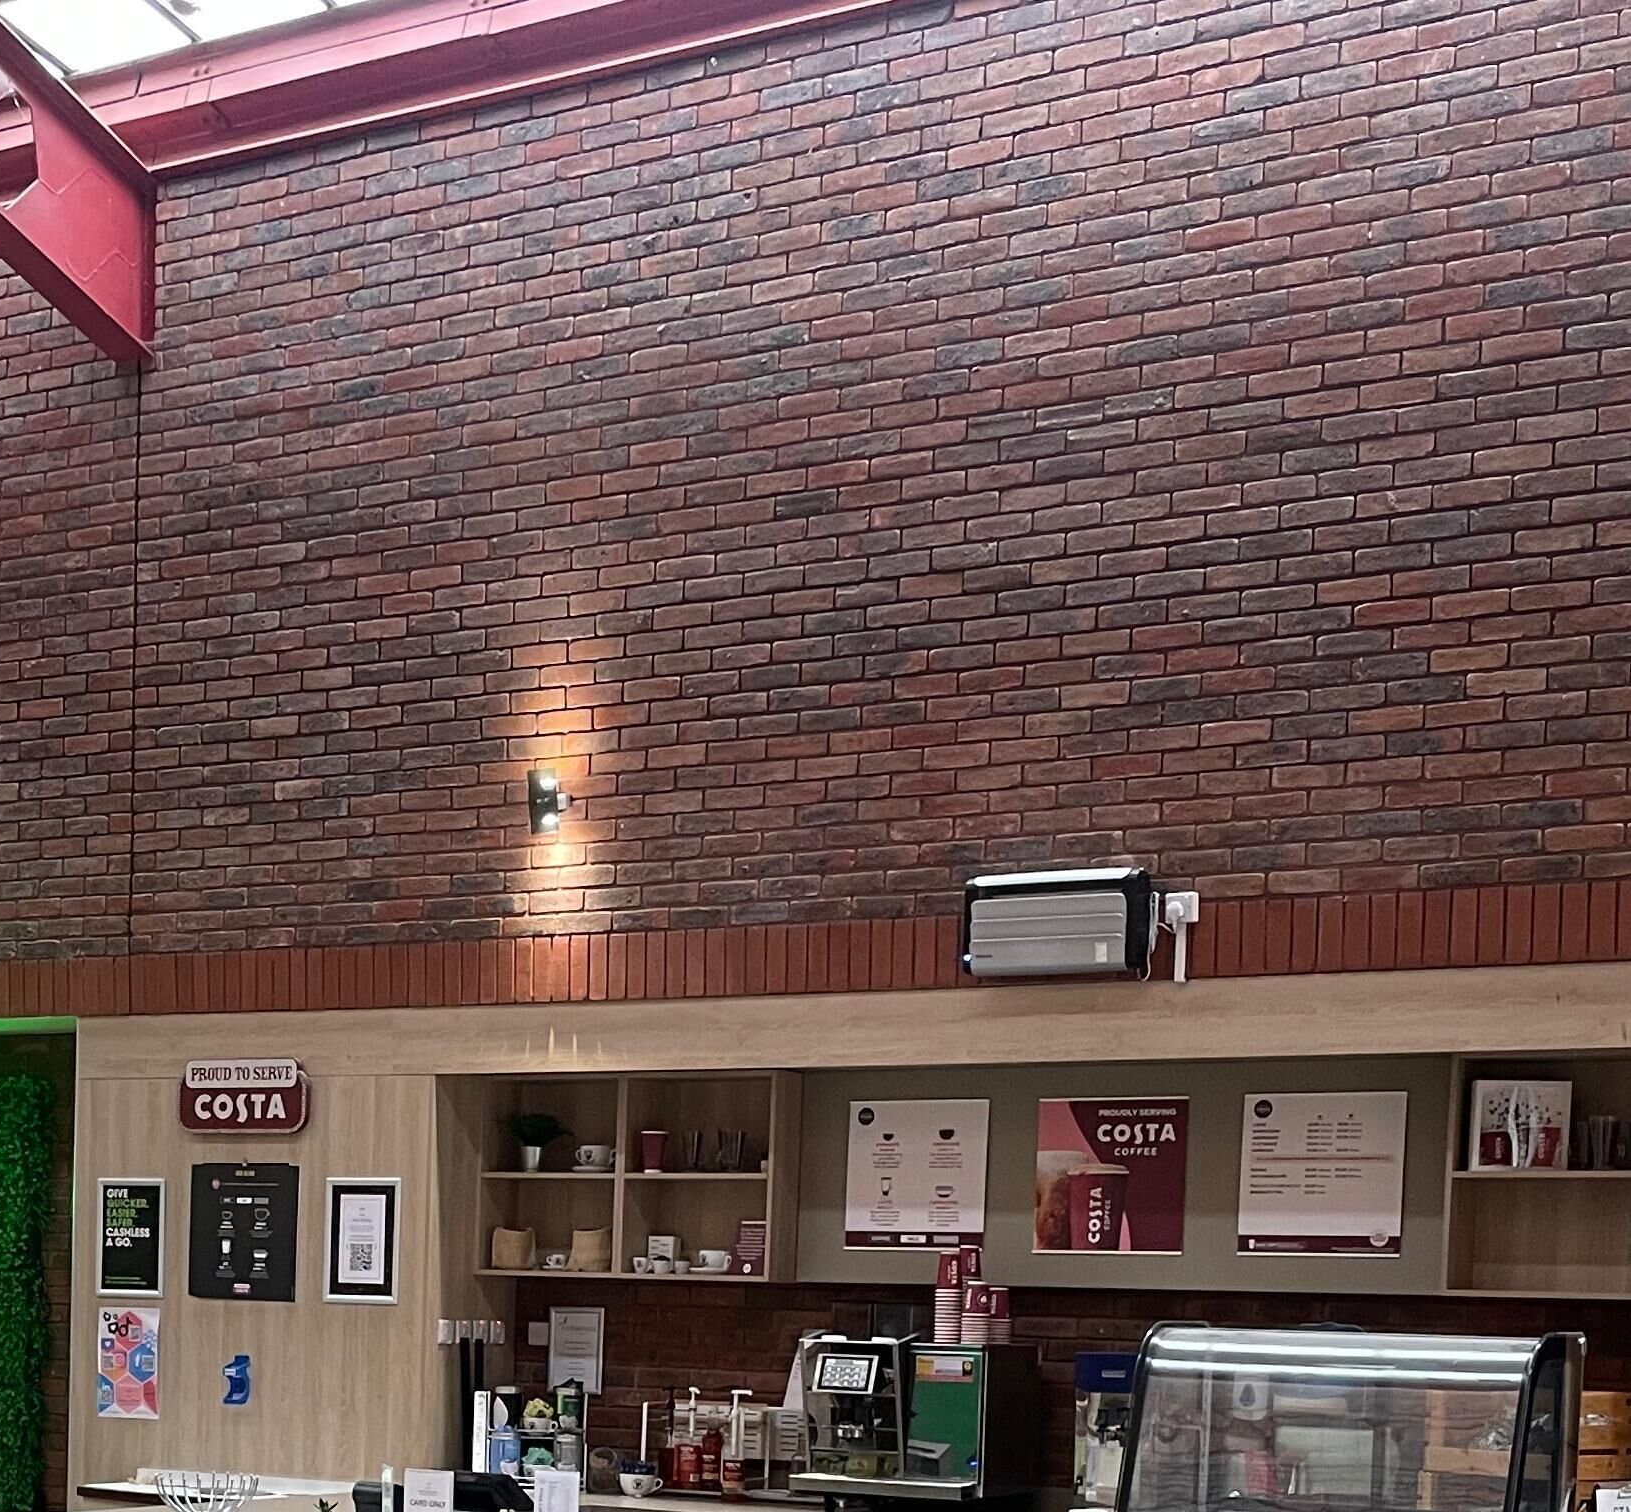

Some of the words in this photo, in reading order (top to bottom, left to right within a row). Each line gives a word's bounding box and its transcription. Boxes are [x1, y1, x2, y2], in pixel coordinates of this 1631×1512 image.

[191, 1067, 232, 1082] PROUD
[234, 1067, 250, 1081] TO
[253, 1065, 292, 1080] SERVE
[194, 1093, 286, 1124] COSTA
[1139, 1108, 1177, 1116] SERVING
[1097, 1123, 1176, 1144] COSTA
[1114, 1147, 1158, 1156] COFFEE
[106, 1188, 129, 1198] GIVE
[106, 1198, 150, 1208] QUICKER.
[106, 1208, 139, 1218] EASIER.
[1088, 1186, 1103, 1244] COSTA
[106, 1218, 135, 1227] SAFER.
[105, 1227, 151, 1238] CASHLESS
[105, 1237, 114, 1247] A
[115, 1237, 133, 1247] GO.
[950, 1260, 958, 1285] COSTA
[409, 1498, 428, 1508] CARD
